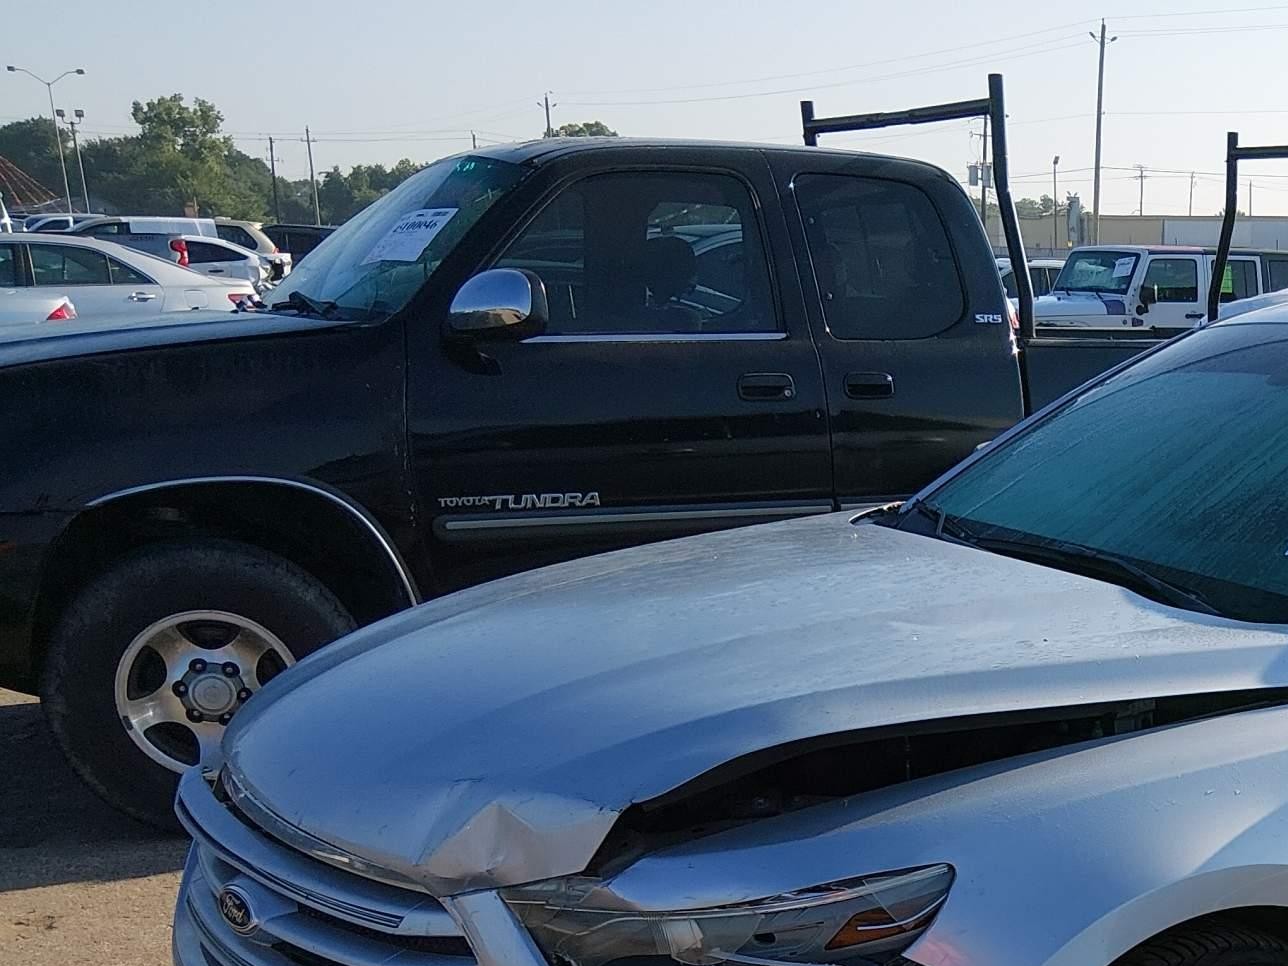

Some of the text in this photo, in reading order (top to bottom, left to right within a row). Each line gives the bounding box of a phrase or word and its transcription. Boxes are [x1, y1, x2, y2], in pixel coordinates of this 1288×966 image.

[974, 314, 1003, 324] SR5
[438, 492, 601, 510] TOYOTA TUNDRA
[223, 894, 245, 922] Ford
